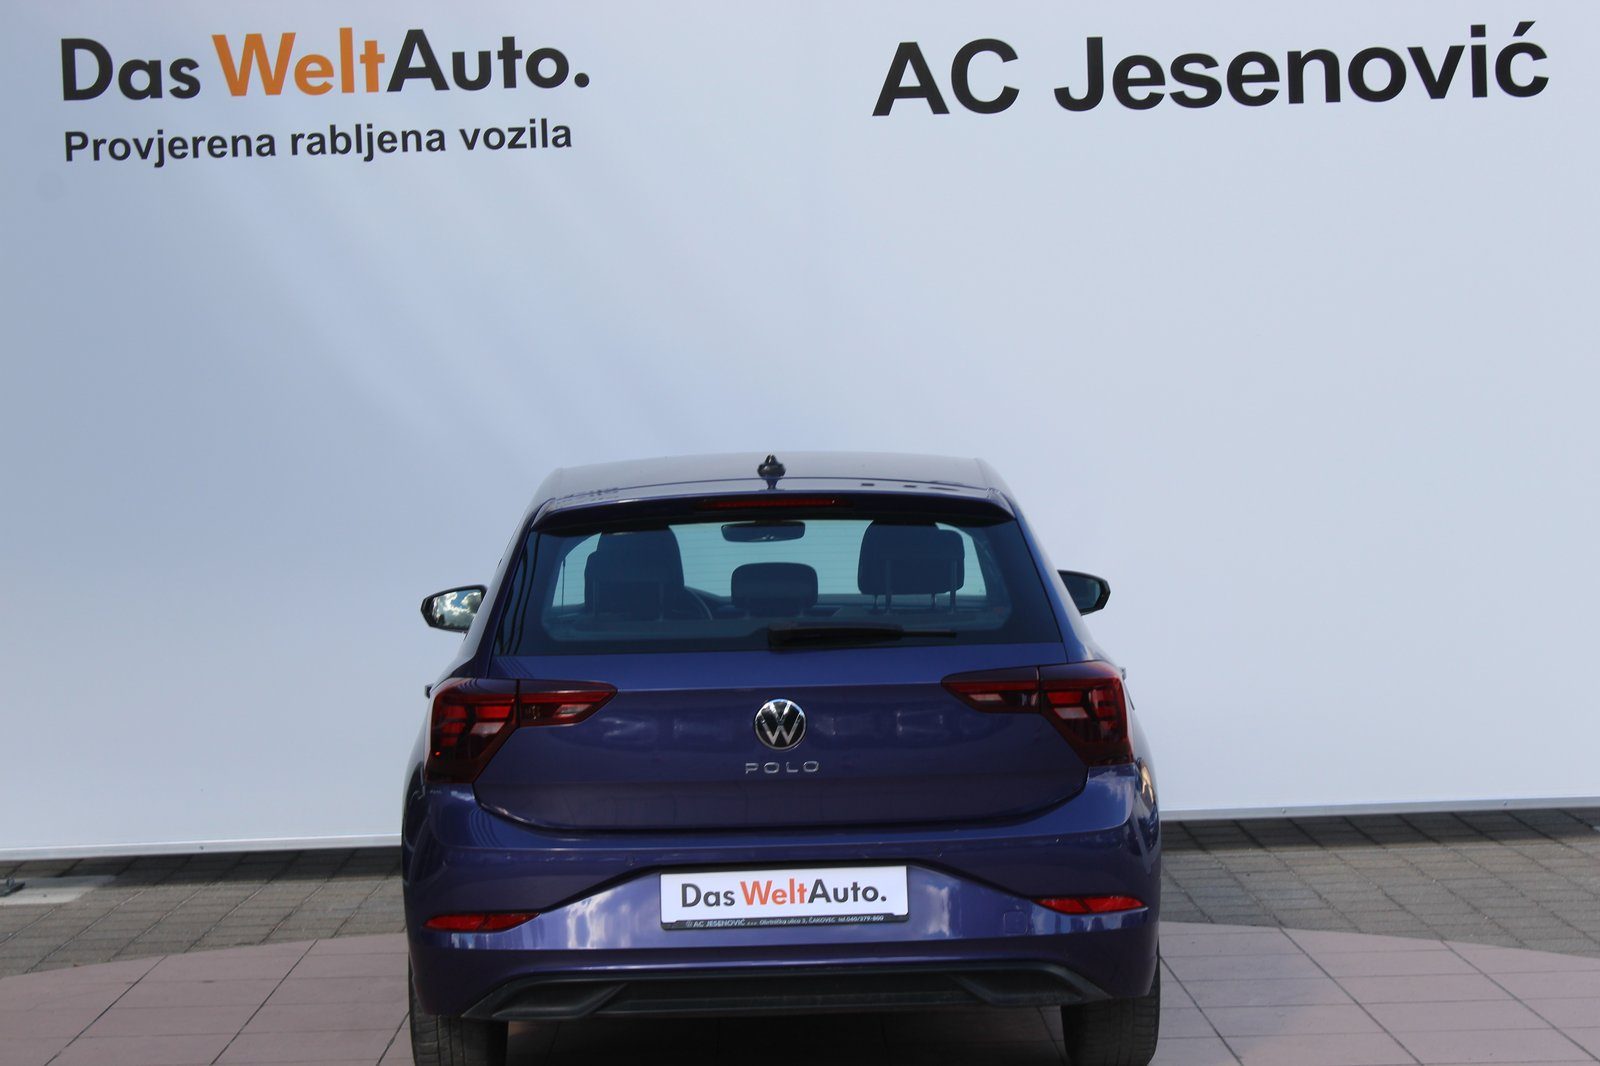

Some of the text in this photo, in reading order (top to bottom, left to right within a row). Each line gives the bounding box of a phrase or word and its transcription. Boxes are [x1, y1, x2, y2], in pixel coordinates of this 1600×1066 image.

[61, 28, 590, 101] Das WeltAuto.
[872, 21, 1549, 116] AC Jesenović
[65, 118, 572, 168] Provjerena rabljena vozila
[745, 760, 820, 775] POLO
[682, 878, 887, 908] Das WeltAuto.
[693, 920, 705, 928] AC
